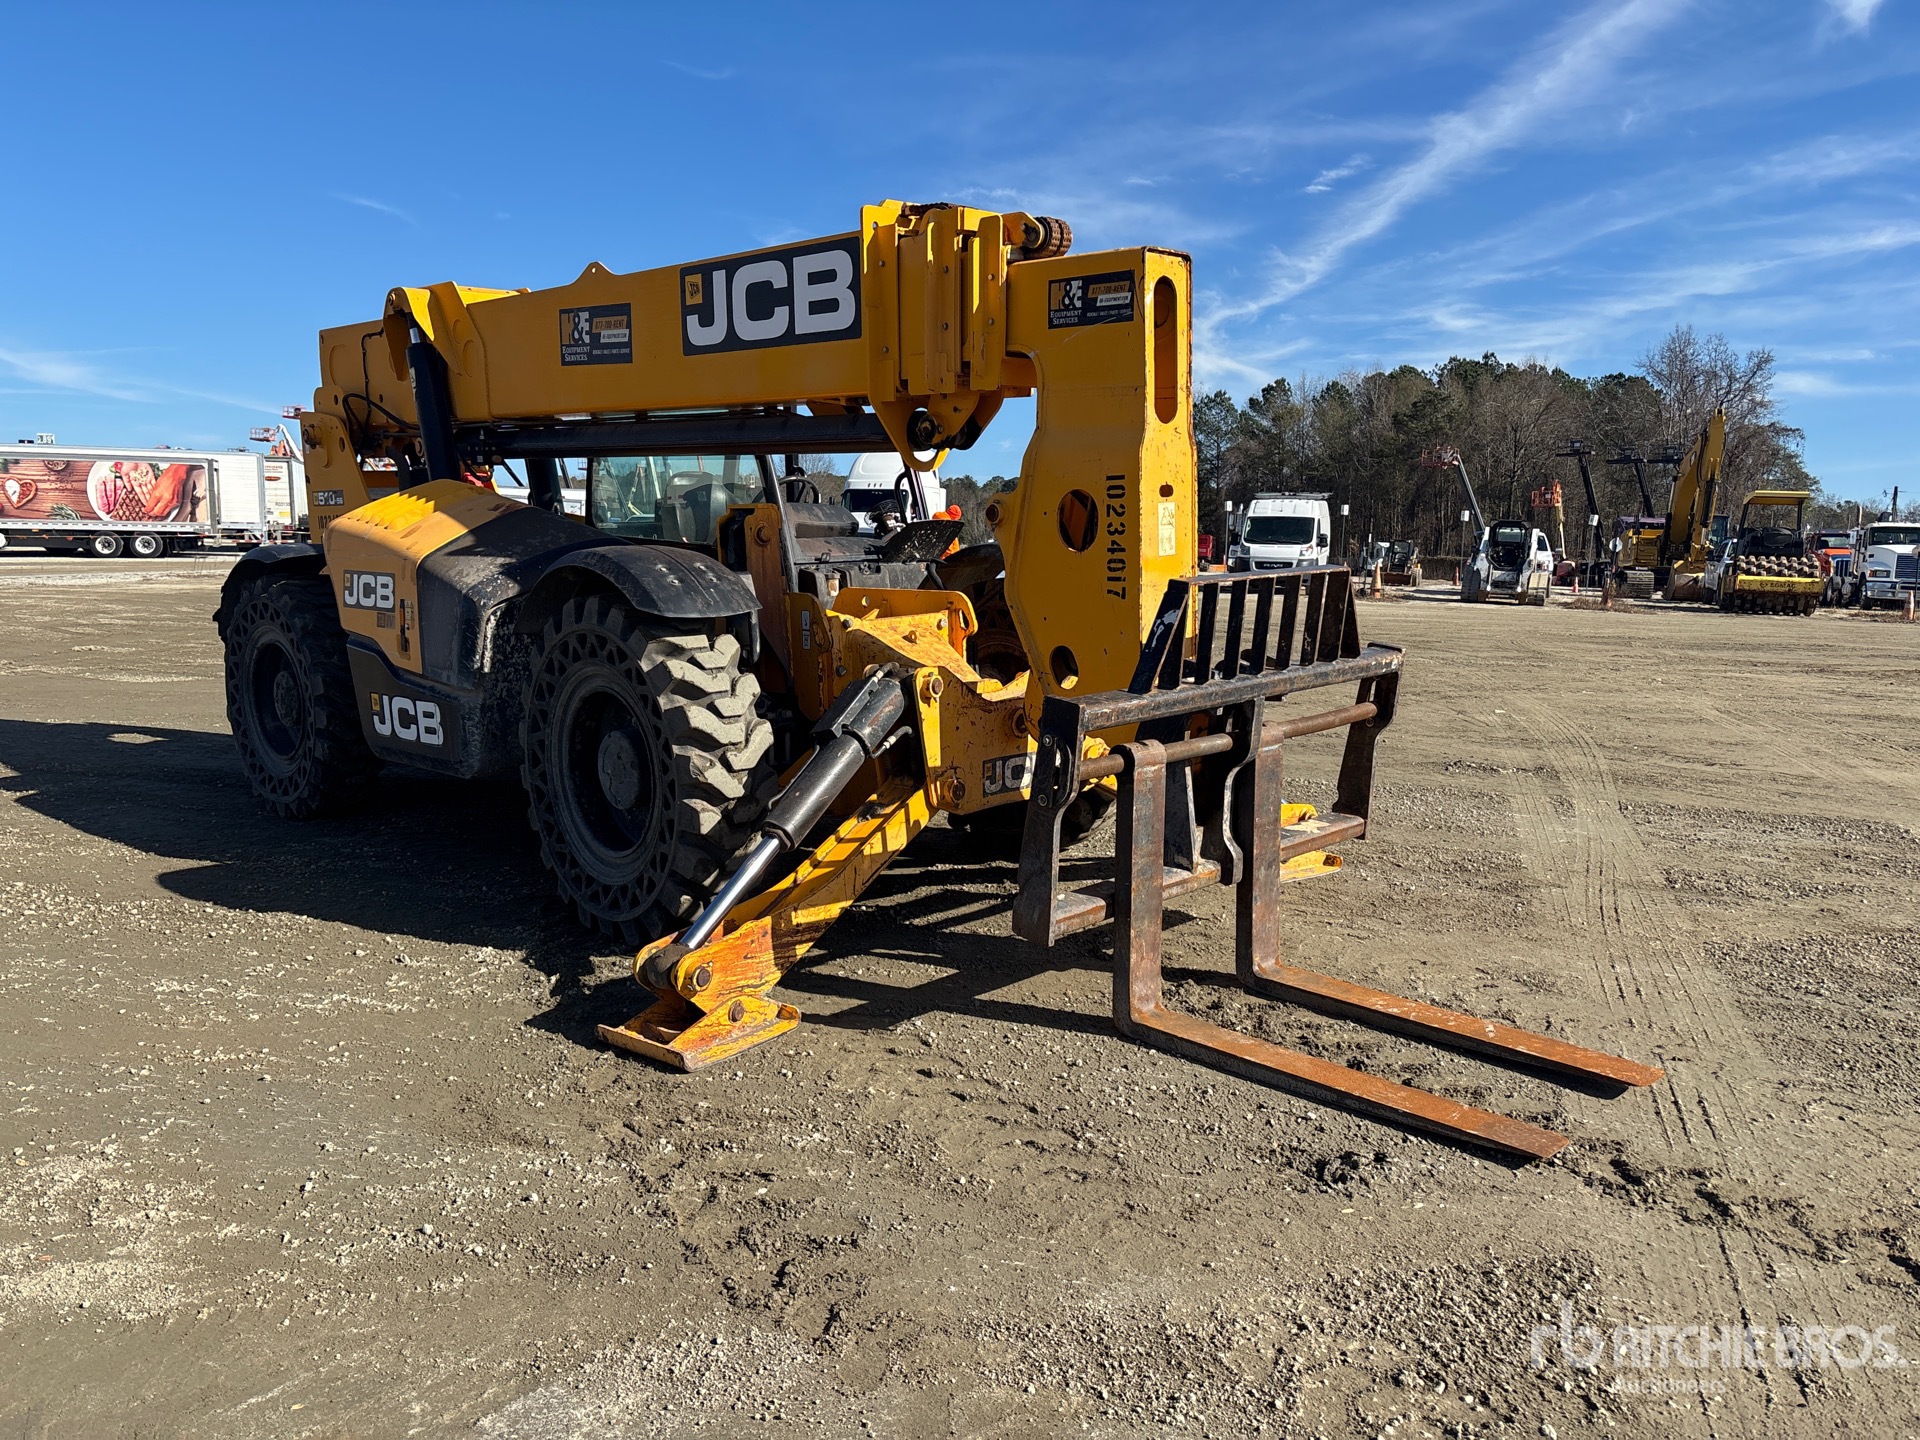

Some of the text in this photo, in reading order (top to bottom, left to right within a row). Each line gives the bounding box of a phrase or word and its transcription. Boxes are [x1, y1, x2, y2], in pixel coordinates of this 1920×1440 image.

[687, 249, 856, 346] JCB
[1050, 280, 1083, 310] H&E
[561, 311, 590, 344] H&E
[1105, 474, 1127, 600] 10234017
[344, 573, 394, 609] JCB
[373, 694, 444, 745] JCB
